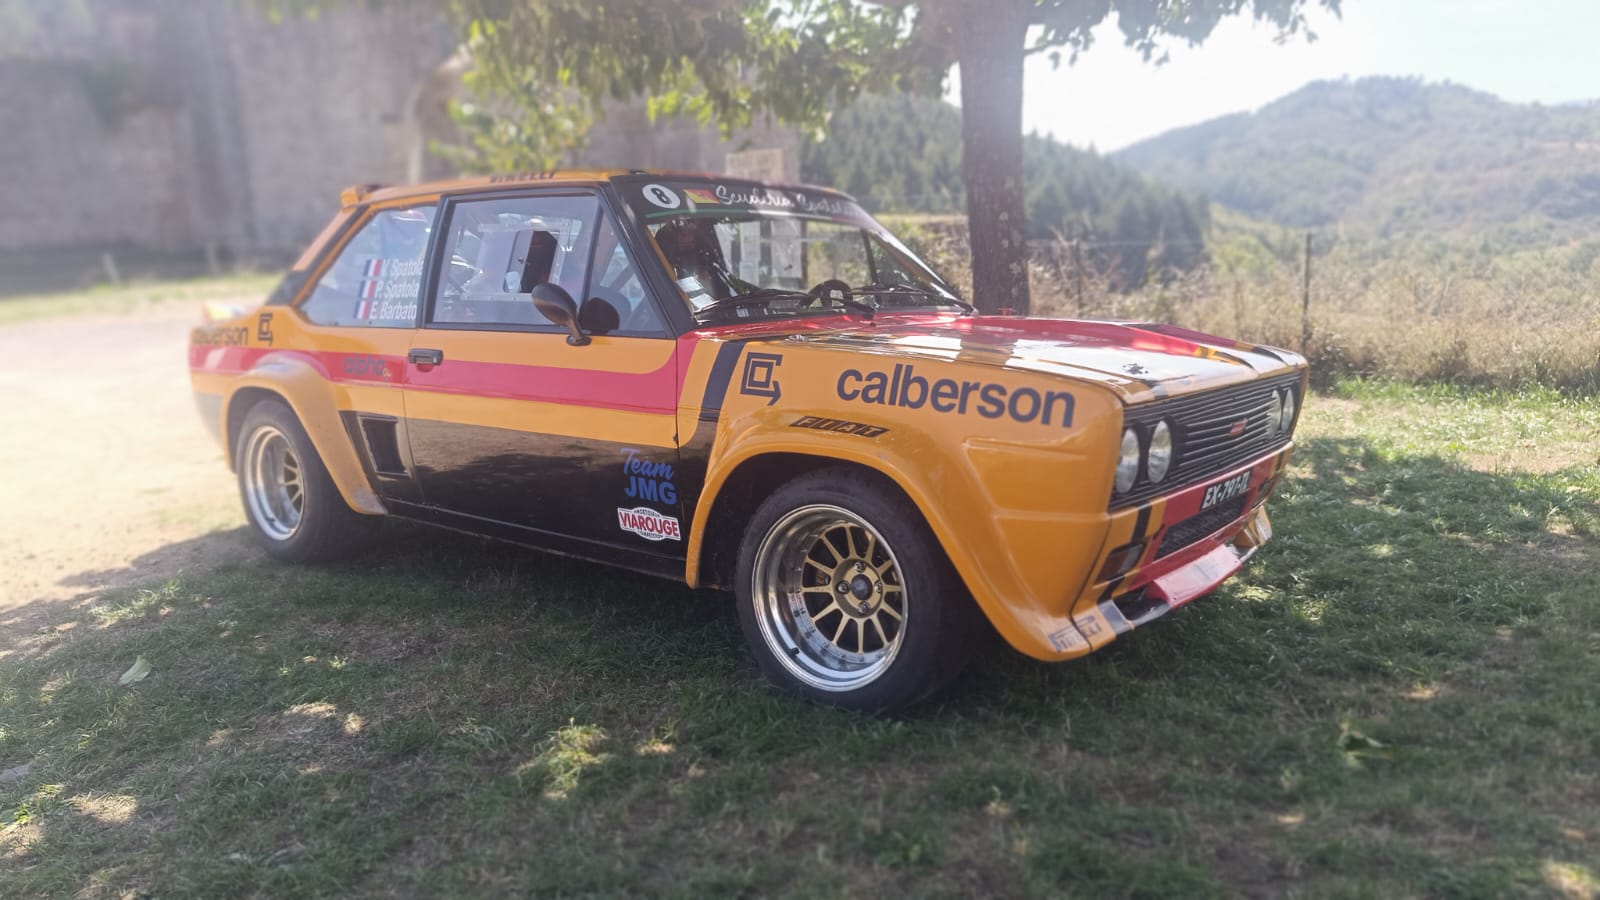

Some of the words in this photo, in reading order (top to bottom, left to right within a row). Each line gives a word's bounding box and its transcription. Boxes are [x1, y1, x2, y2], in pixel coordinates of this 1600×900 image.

[651, 188, 672, 204] 8
[384, 281, 419, 301] Spatola
[380, 301, 417, 320] Barbato
[837, 363, 1076, 428] calberson
[797, 417, 881, 435] FIAT
[620, 448, 674, 480] Team
[624, 476, 677, 505] JMG
[620, 512, 679, 537] VIAROUGE
